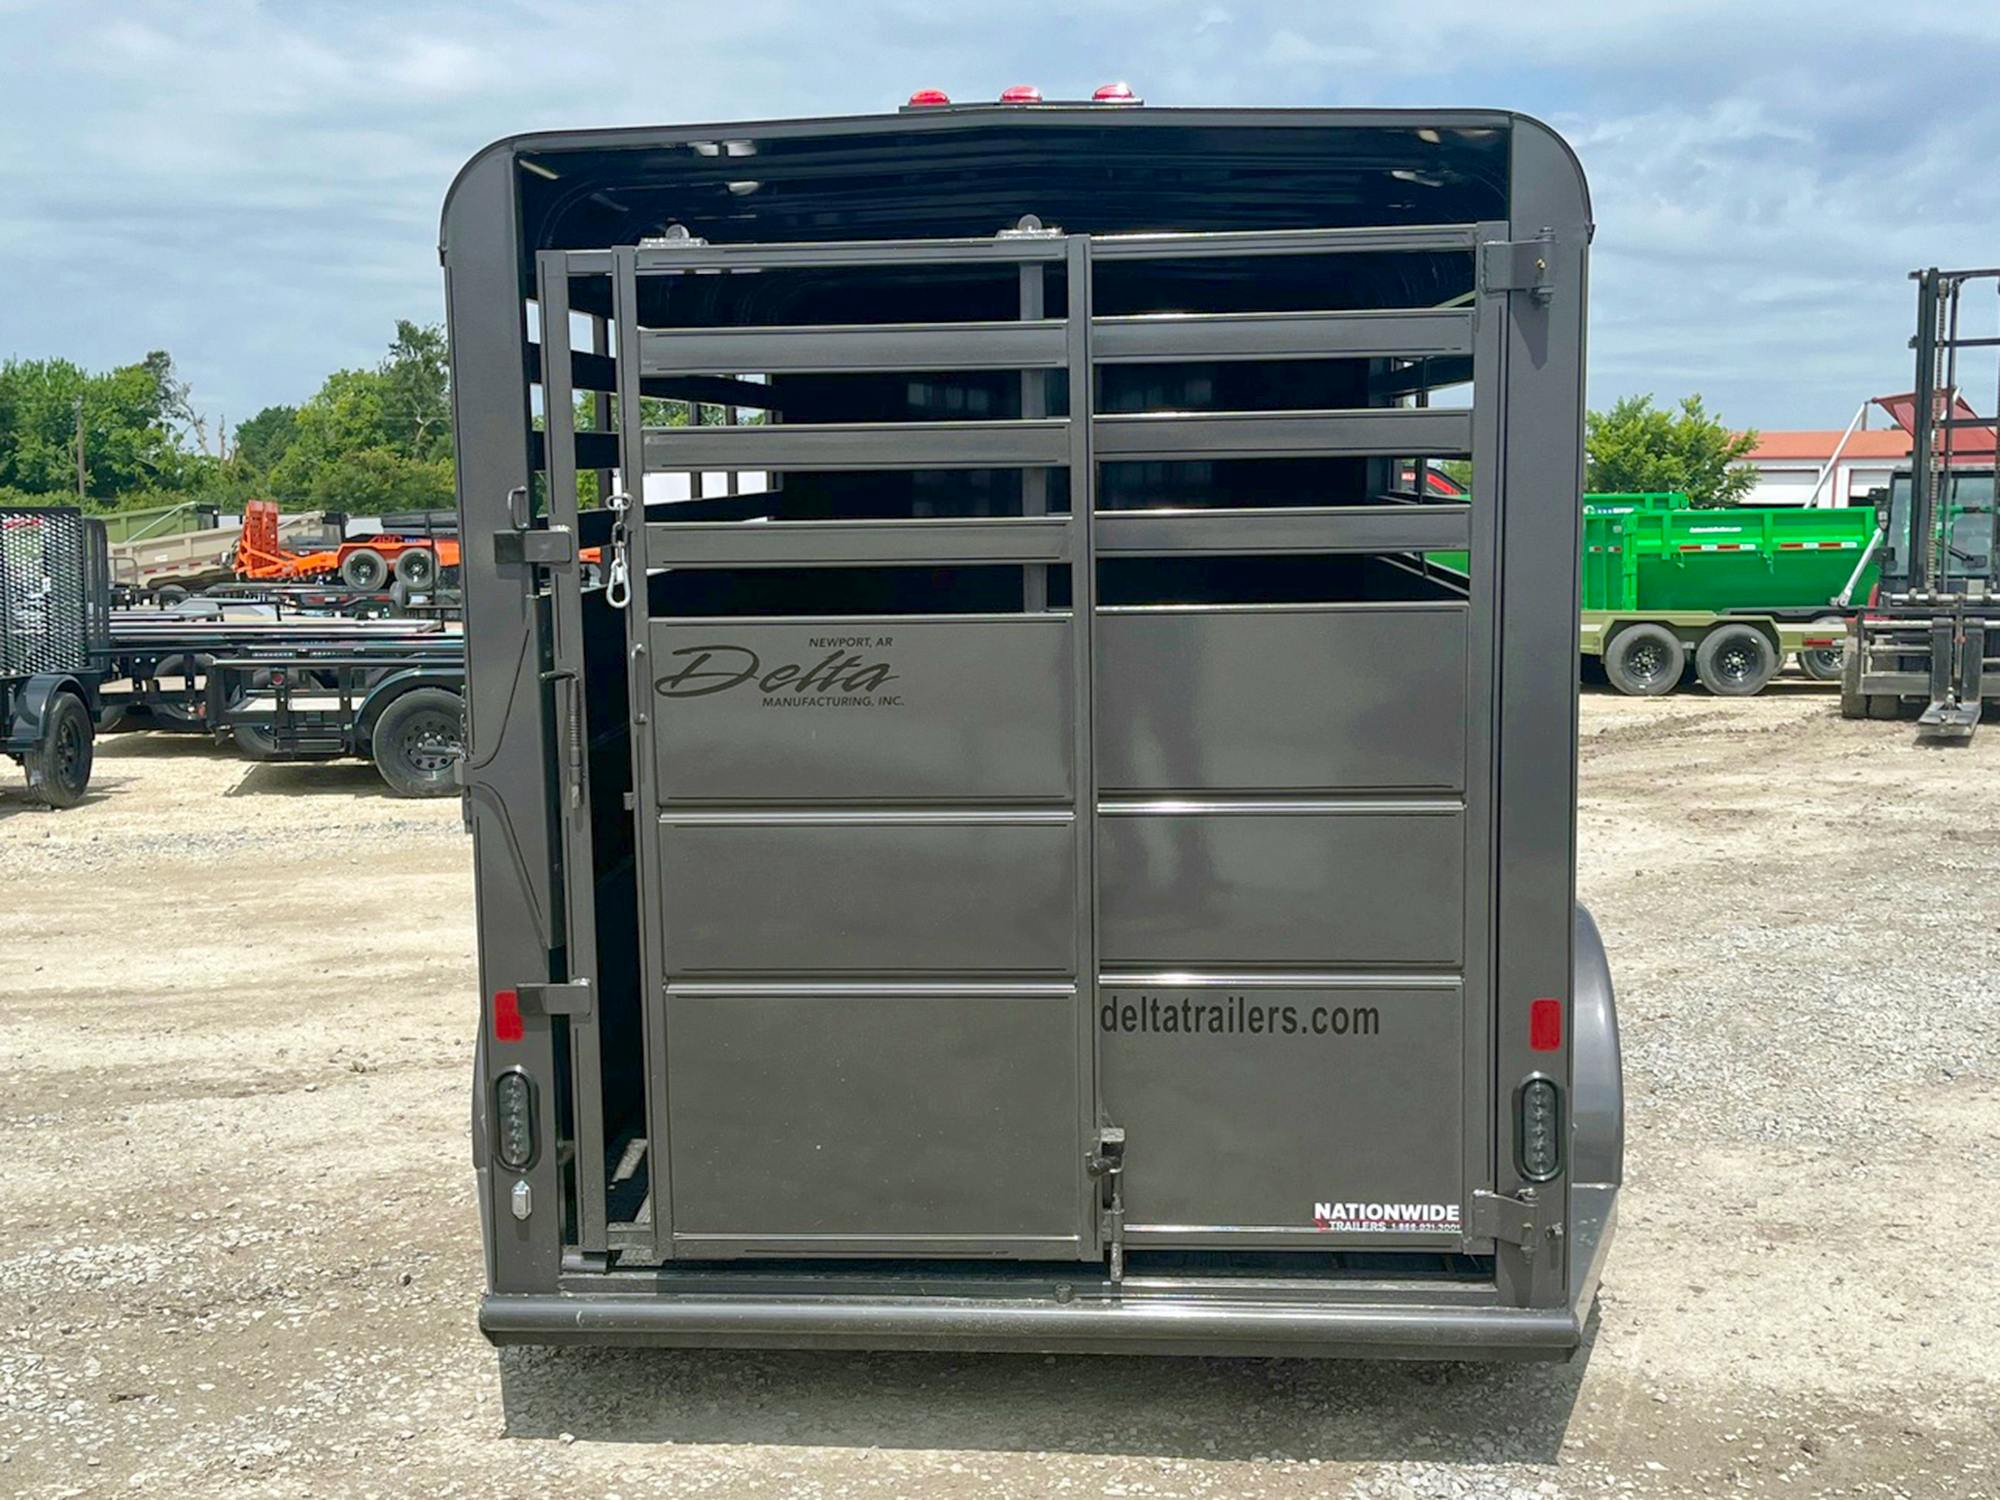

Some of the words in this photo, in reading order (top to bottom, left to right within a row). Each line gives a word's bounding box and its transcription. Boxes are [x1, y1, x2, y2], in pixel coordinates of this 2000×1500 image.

[808, 637, 872, 648] NEWPORT,
[875, 637, 893, 647] AR
[655, 645, 899, 698] Delta
[762, 696, 874, 708] MANUFACTURING,
[878, 696, 904, 706] INC.
[1100, 996, 1380, 1035] deltatrailers.com
[1315, 1203, 1460, 1221] NATIONWIDE
[1328, 1221, 1386, 1232] TRAILERS
